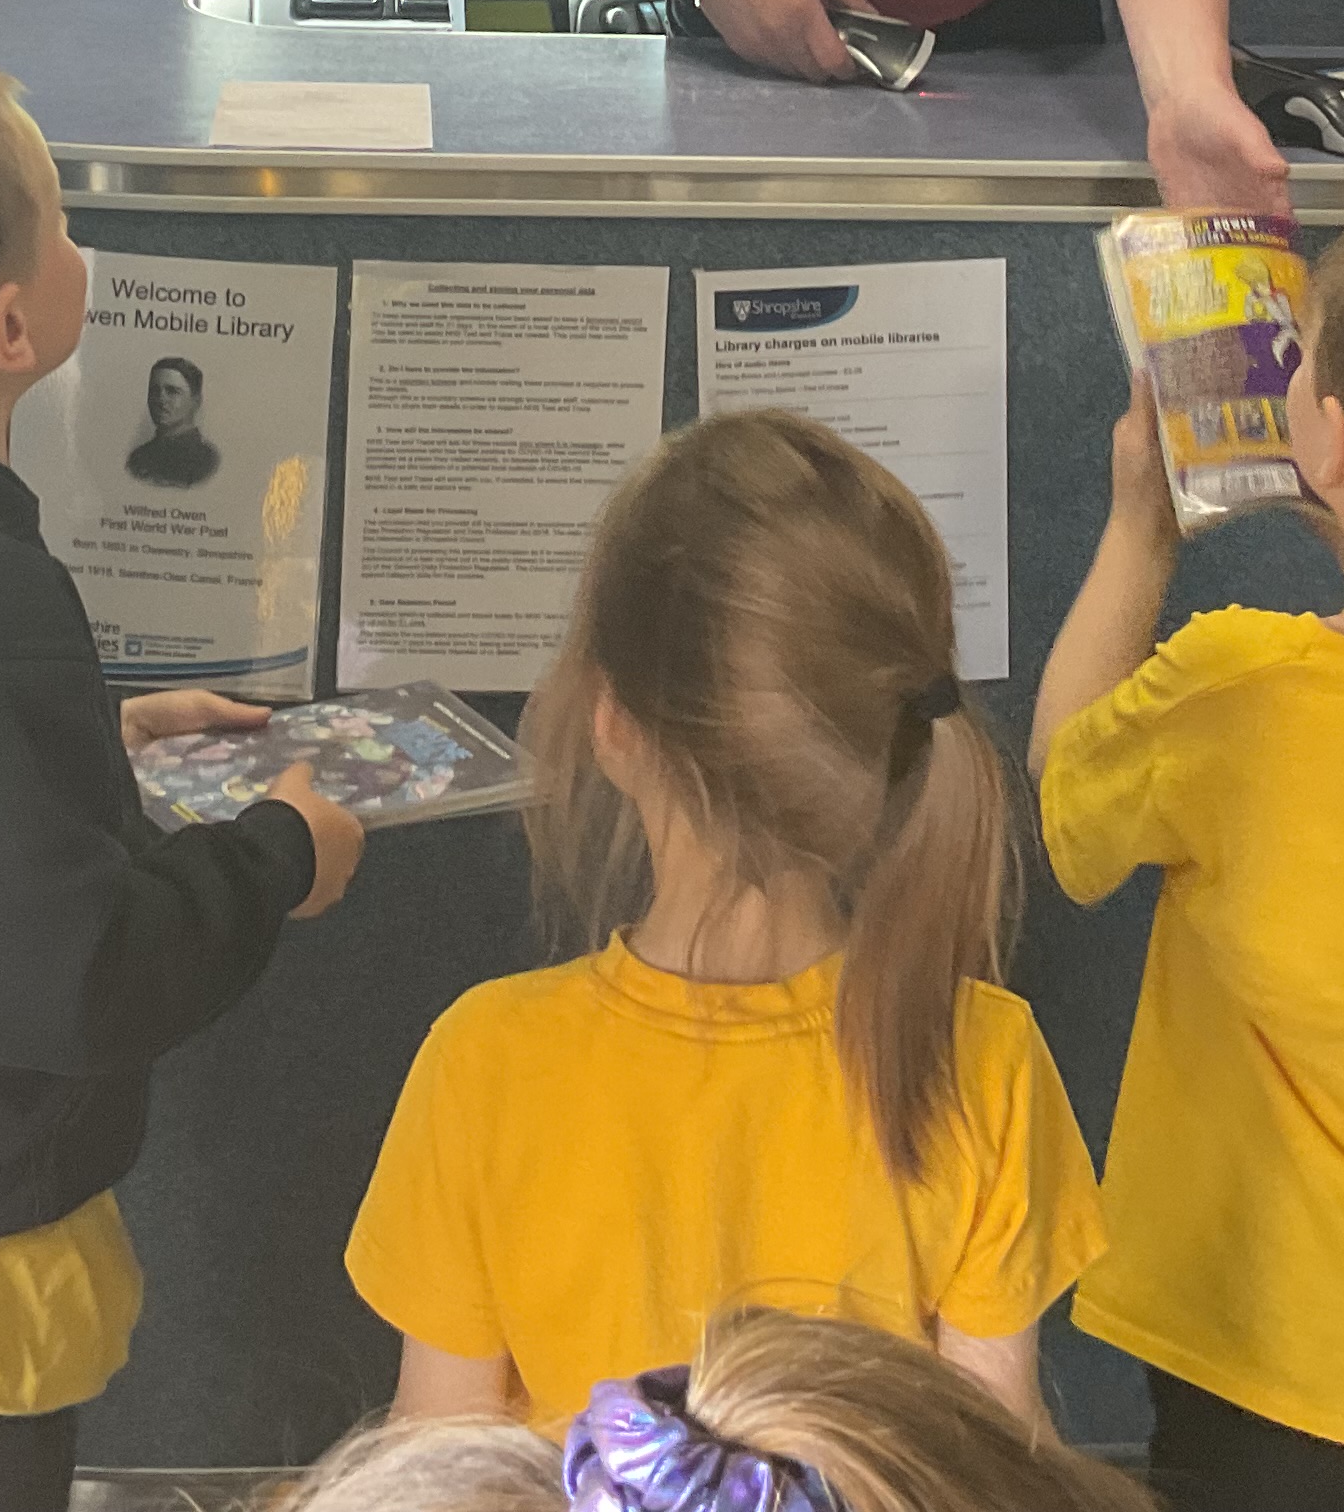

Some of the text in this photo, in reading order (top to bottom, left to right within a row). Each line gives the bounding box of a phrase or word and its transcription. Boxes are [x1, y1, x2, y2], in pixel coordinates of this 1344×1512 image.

[112, 276, 246, 308] Welcome to
[752, 298, 822, 316] Shropshire
[84, 309, 295, 343] wen Mobile Library
[715, 331, 941, 353] Library charges on mobile libraries
[123, 504, 207, 522] Wilfred Owen
[130, 520, 167, 535] World
[170, 522, 196, 536] War
